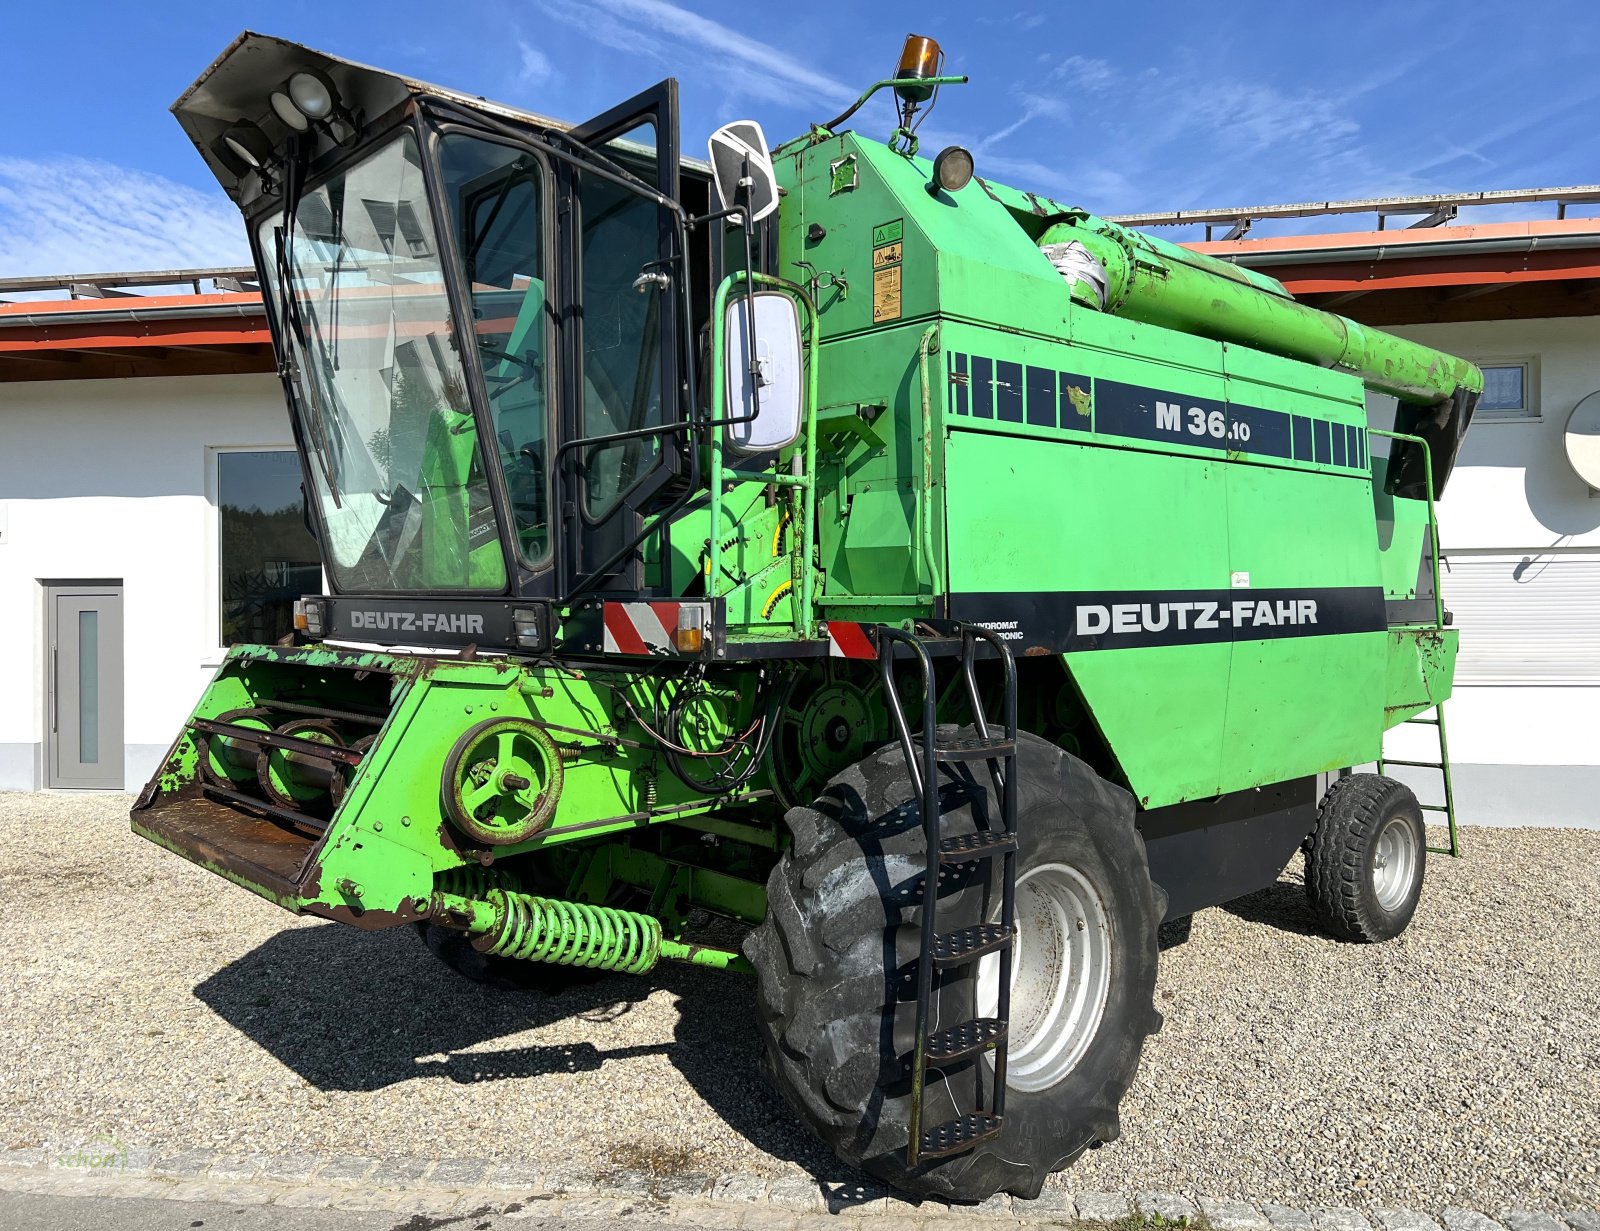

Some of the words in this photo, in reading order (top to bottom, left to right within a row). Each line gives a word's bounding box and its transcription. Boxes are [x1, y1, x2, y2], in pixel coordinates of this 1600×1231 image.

[1155, 401, 1182, 432] M
[1187, 407, 1251, 442] 36.10
[350, 610, 484, 635] DEUTZ-FAHR
[1076, 599, 1318, 636] DEUTZ-FAHR
